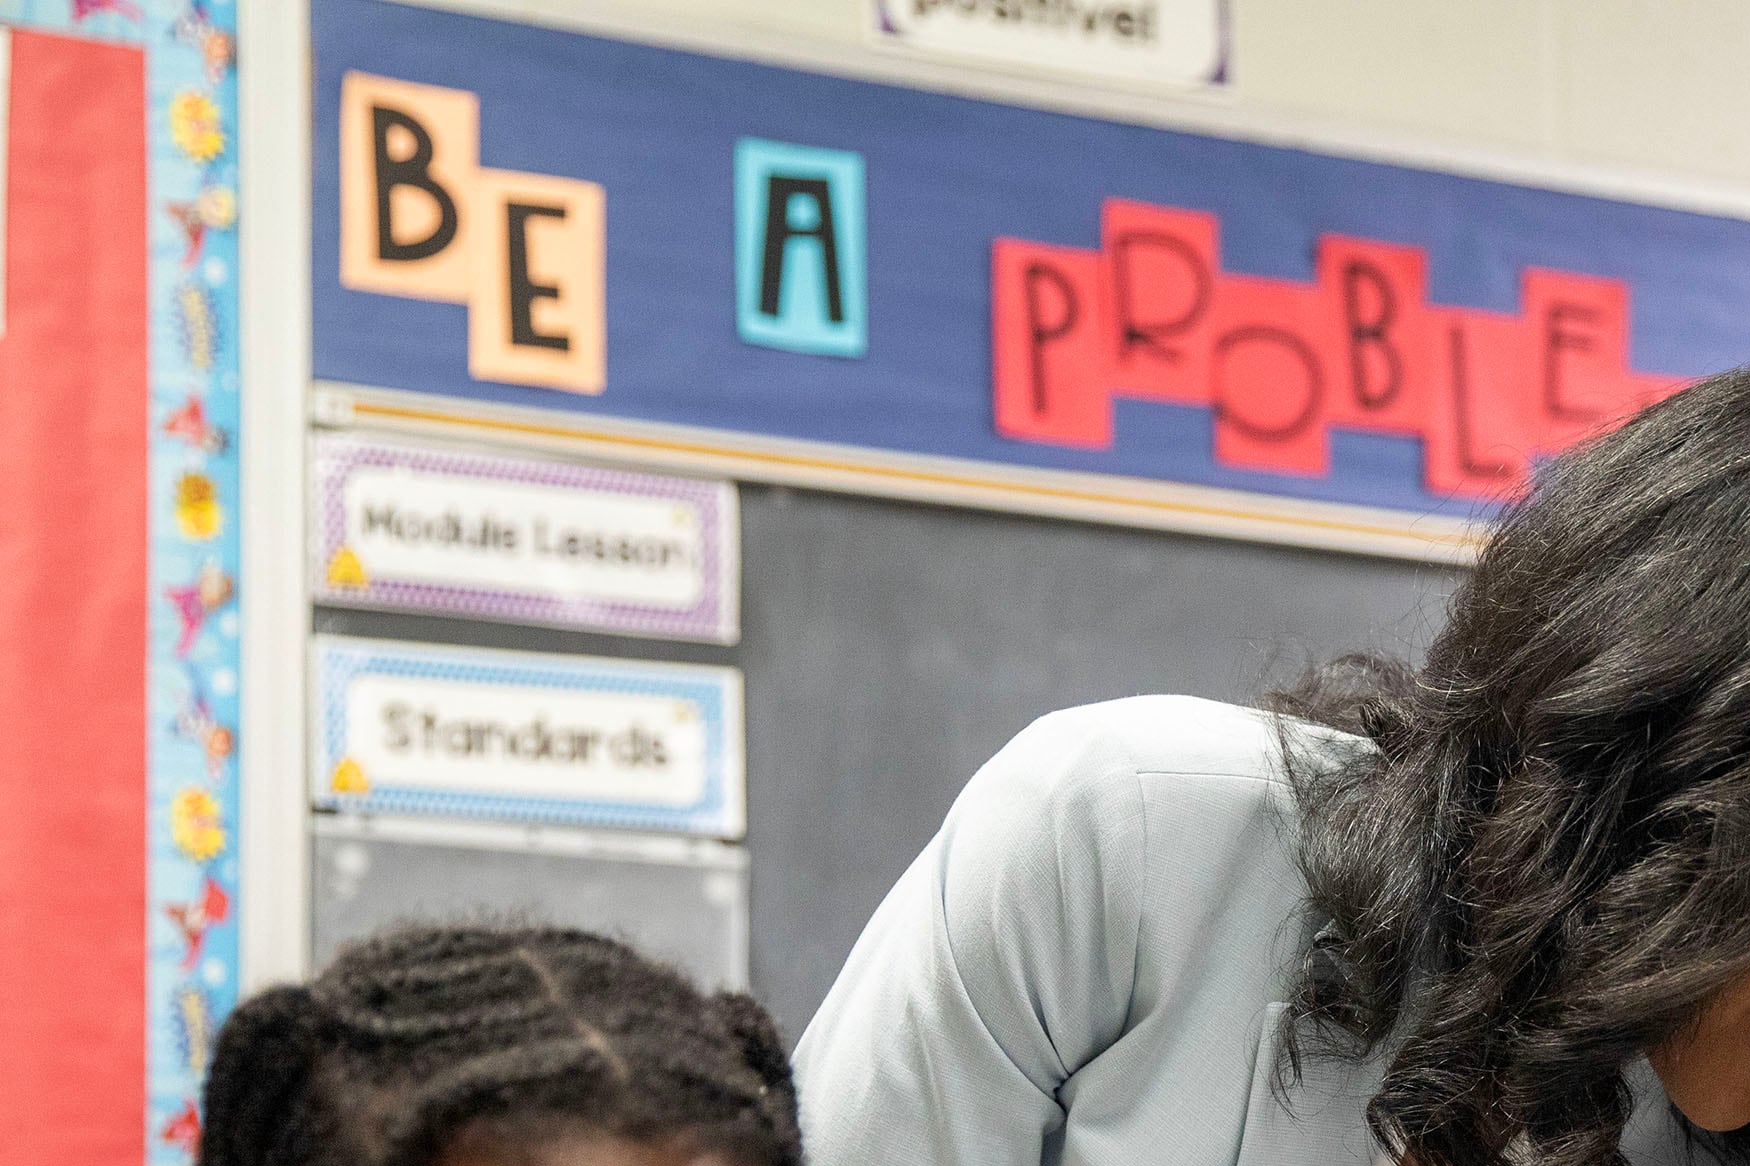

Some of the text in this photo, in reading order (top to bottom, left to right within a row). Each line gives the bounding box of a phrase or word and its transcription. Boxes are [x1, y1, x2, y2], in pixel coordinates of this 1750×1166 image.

[371, 103, 570, 352] BE
[758, 174, 844, 323] A
[1022, 228, 1606, 478] PROBLE
[532, 519, 692, 568] Lesson
[379, 701, 672, 769] Standards
